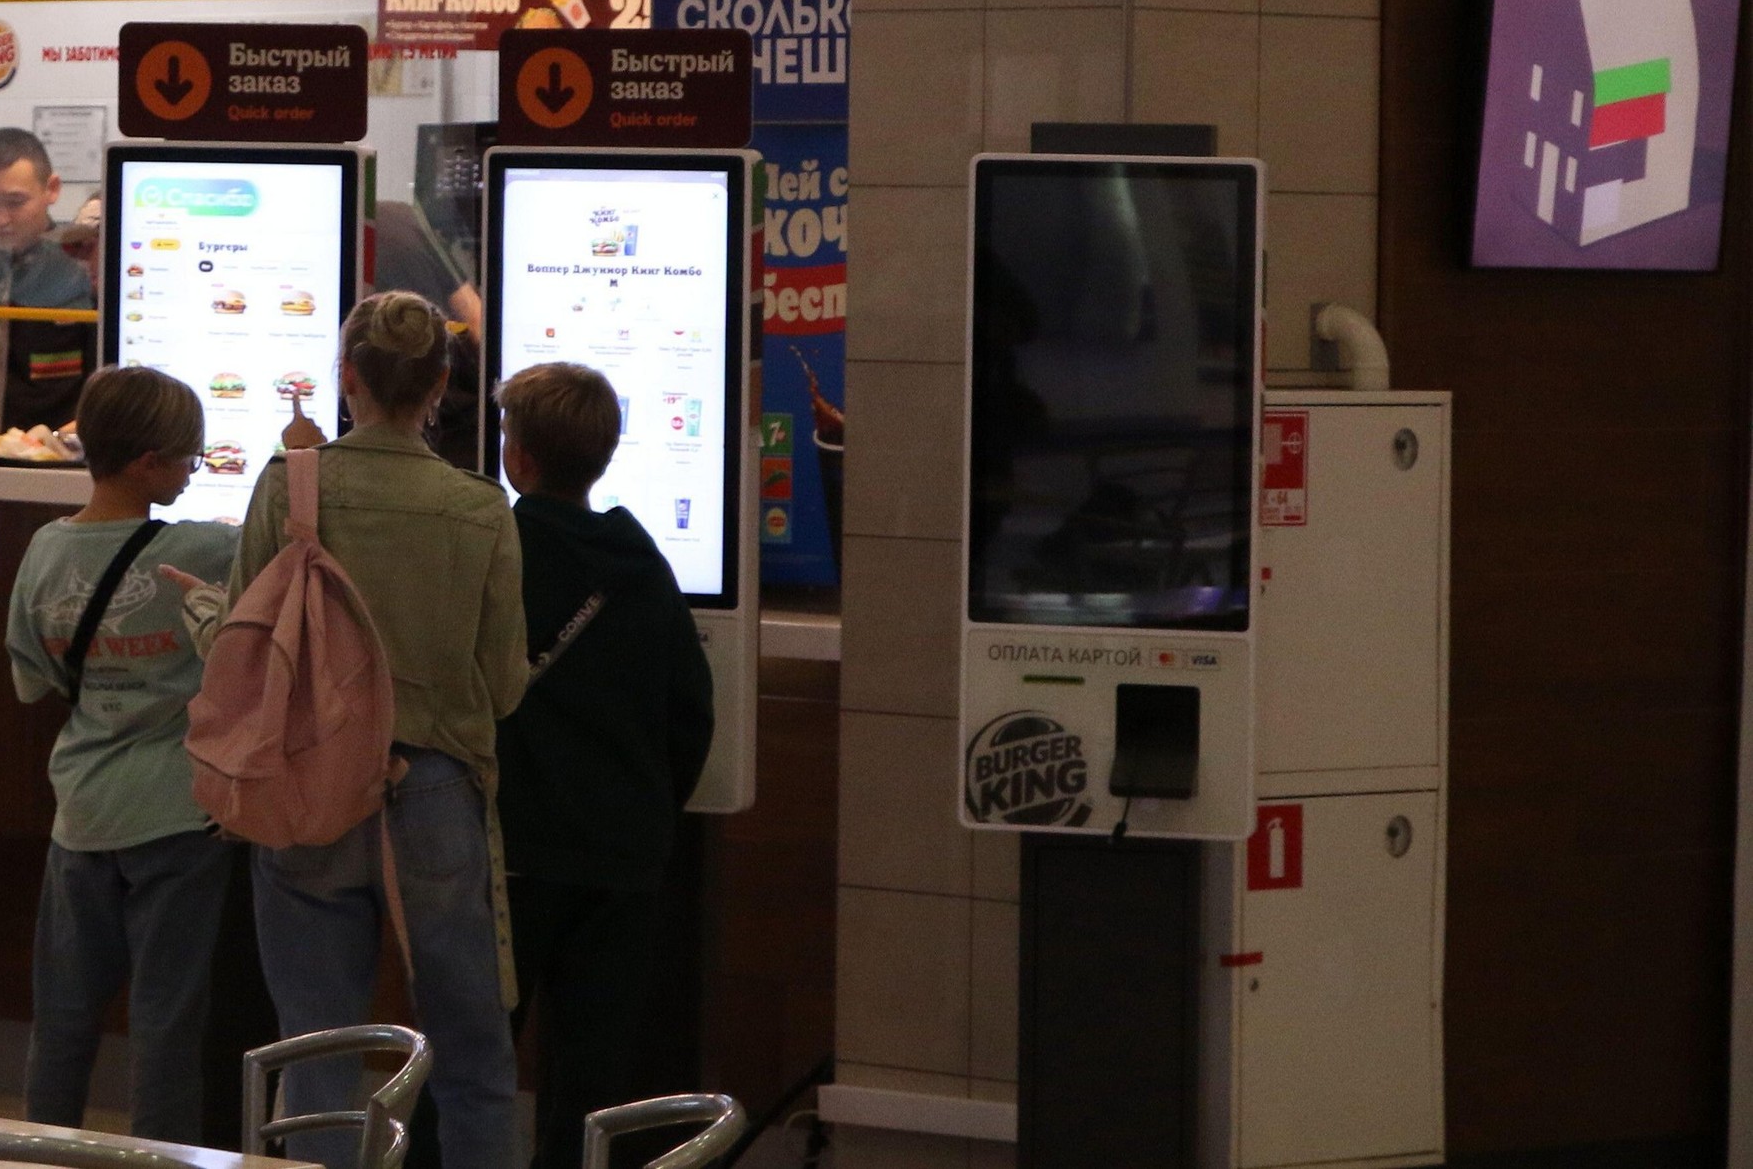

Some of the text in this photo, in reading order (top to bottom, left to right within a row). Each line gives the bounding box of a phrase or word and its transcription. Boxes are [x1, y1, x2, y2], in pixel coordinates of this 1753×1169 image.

[41, 45, 62, 62] МЫ
[229, 42, 350, 73] Быстрый
[611, 48, 735, 78] Быстрый
[228, 75, 302, 94] заказ
[610, 81, 685, 100] заказ
[228, 105, 316, 121] Quick order
[610, 112, 697, 128] Quick order
[165, 186, 256, 208] Спасибо
[198, 241, 249, 253] Бургеры
[527, 263, 703, 277] Воппер Джуниор Кинг Комбо
[988, 644, 1141, 668] ОПЛАТА КАРТОЙ
[1191, 655, 1218, 666] VISA
[975, 734, 1083, 782] BURGER
[979, 758, 1088, 817] KING
